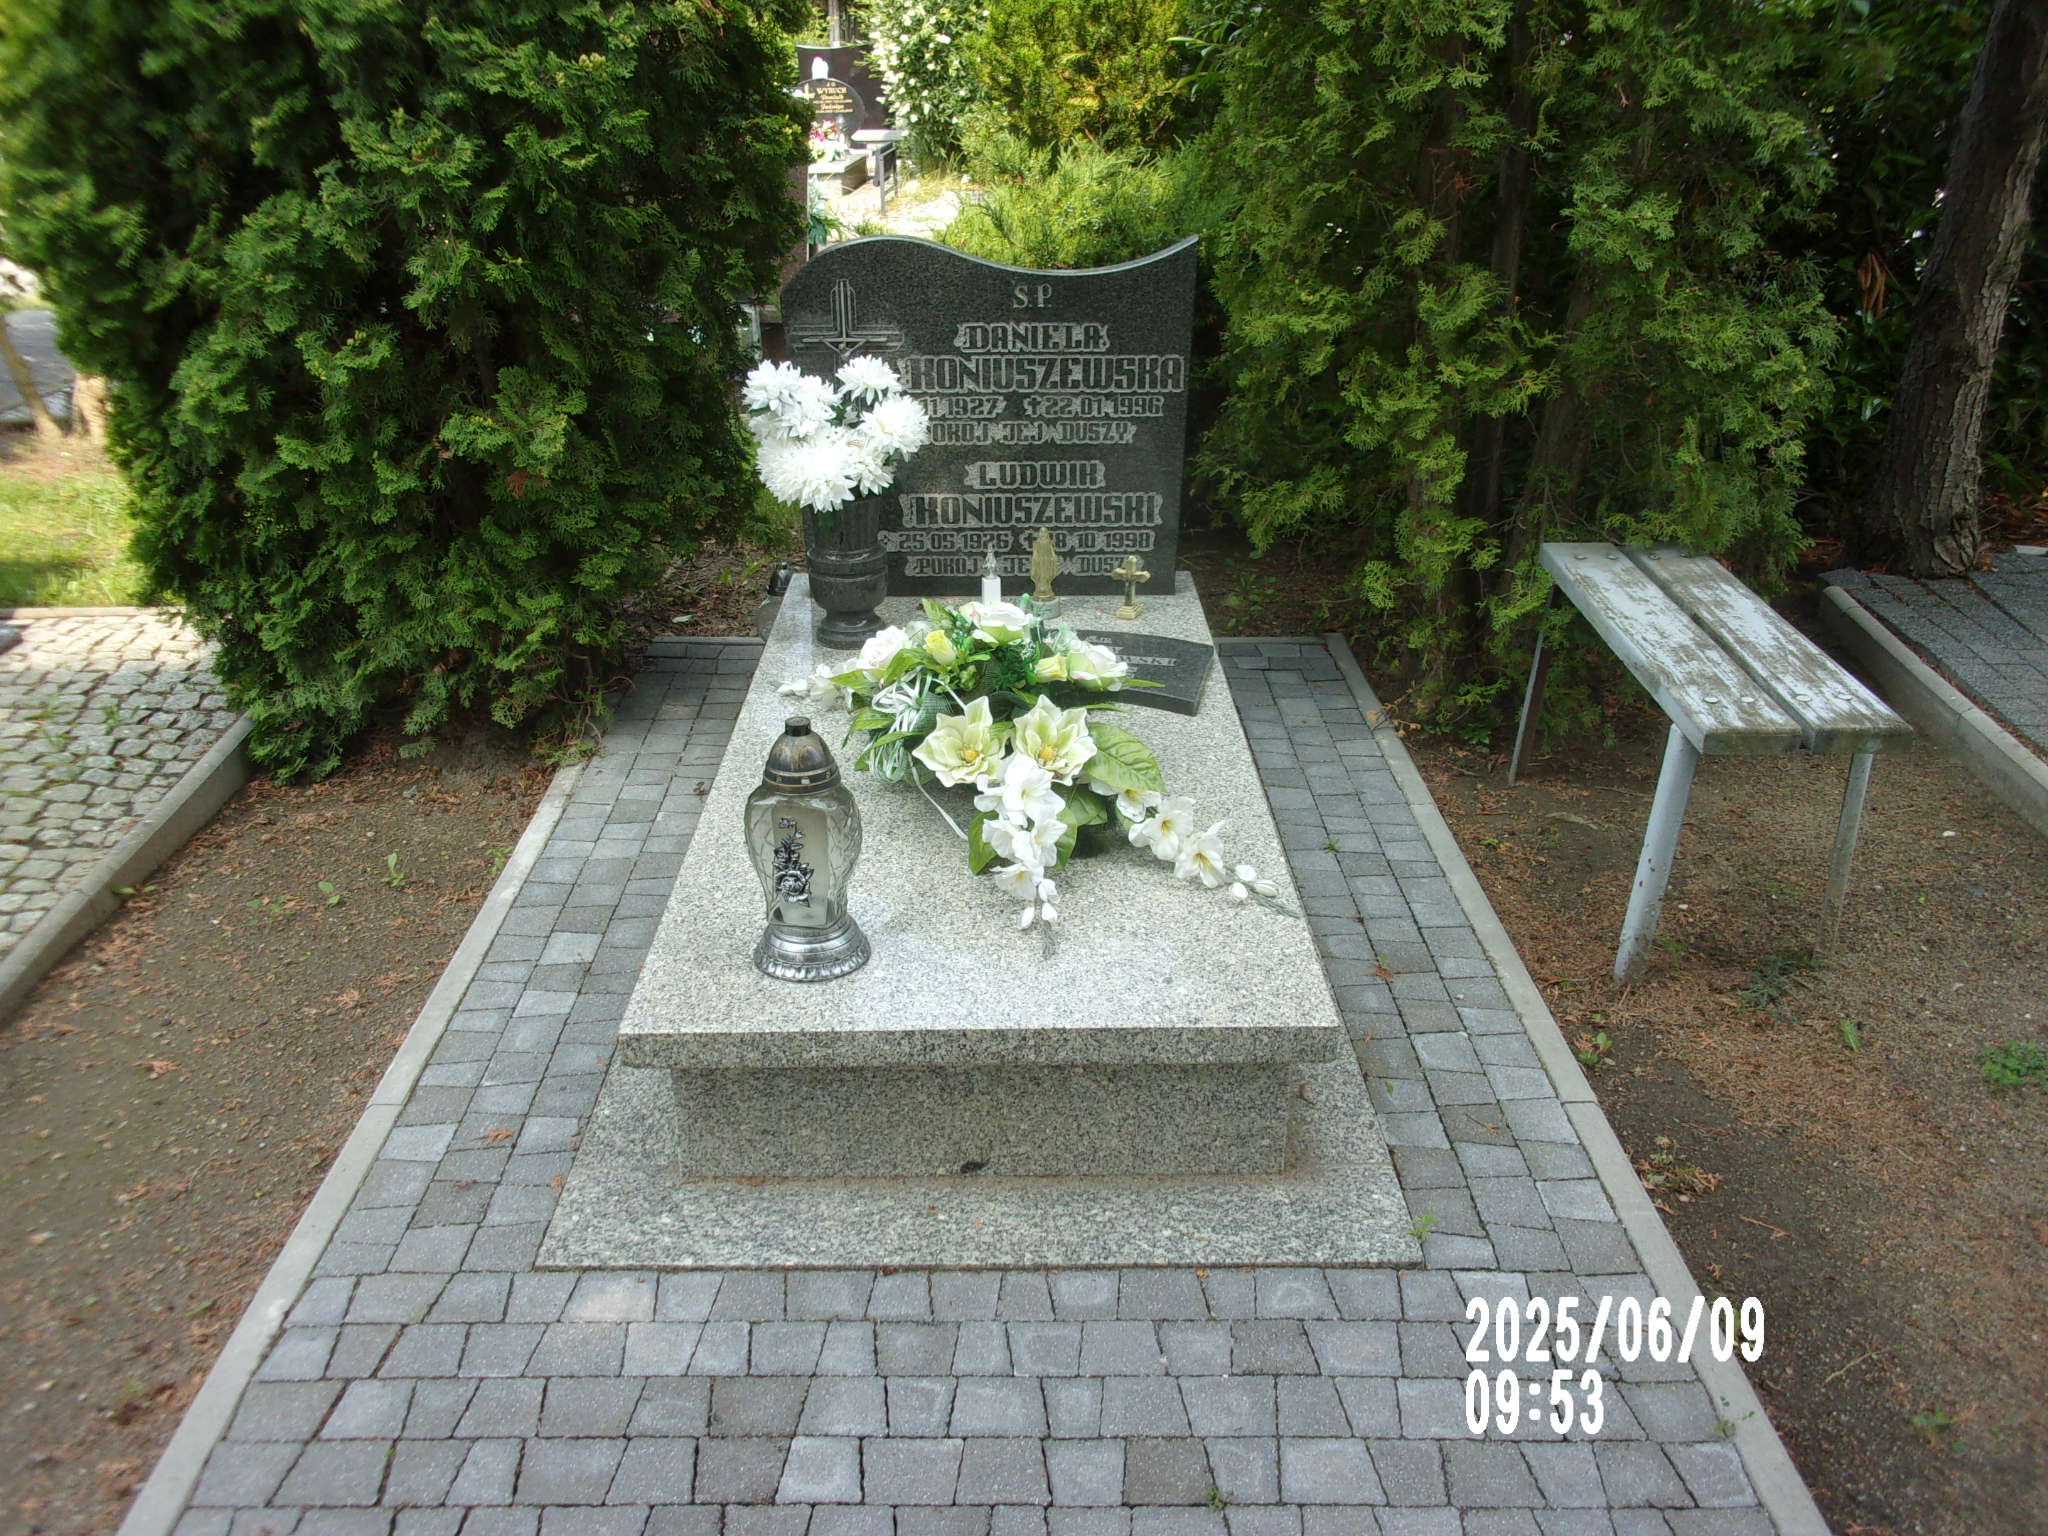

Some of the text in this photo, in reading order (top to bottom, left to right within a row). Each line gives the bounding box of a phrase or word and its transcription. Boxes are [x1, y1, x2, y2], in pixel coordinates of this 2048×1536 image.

[960, 322, 1107, 352] DANIELA
[904, 355, 1185, 392] KONIUSZEWSKA
[1059, 421, 1131, 445] DUSZY
[974, 461, 1103, 488] LUDWIK
[909, 493, 1162, 527] KONIUSZEWSKI
[1001, 556, 1034, 576] JE
[1078, 556, 1138, 576] DUSZ
